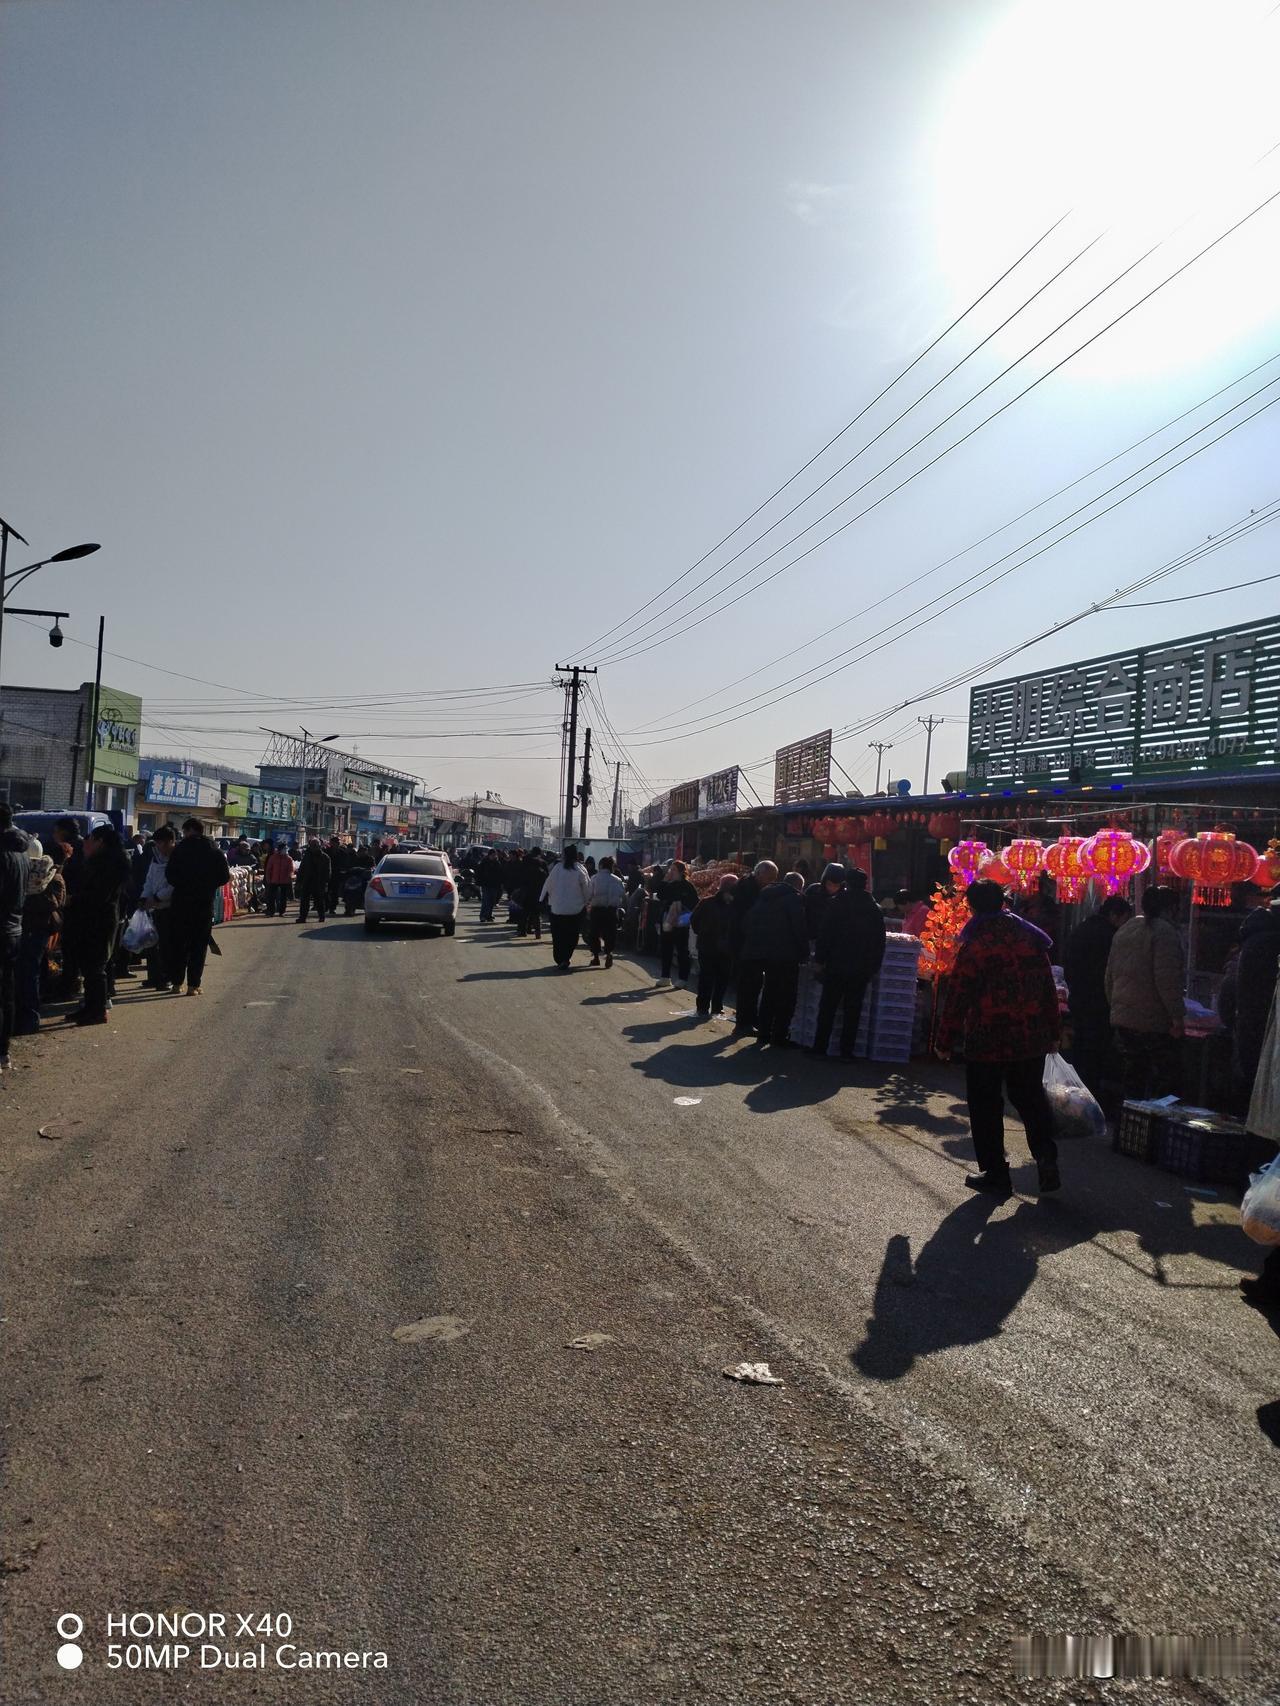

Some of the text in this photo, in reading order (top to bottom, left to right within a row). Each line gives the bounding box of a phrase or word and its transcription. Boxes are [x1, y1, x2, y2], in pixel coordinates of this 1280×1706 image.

[972, 634, 1256, 753] 光明综合商店
